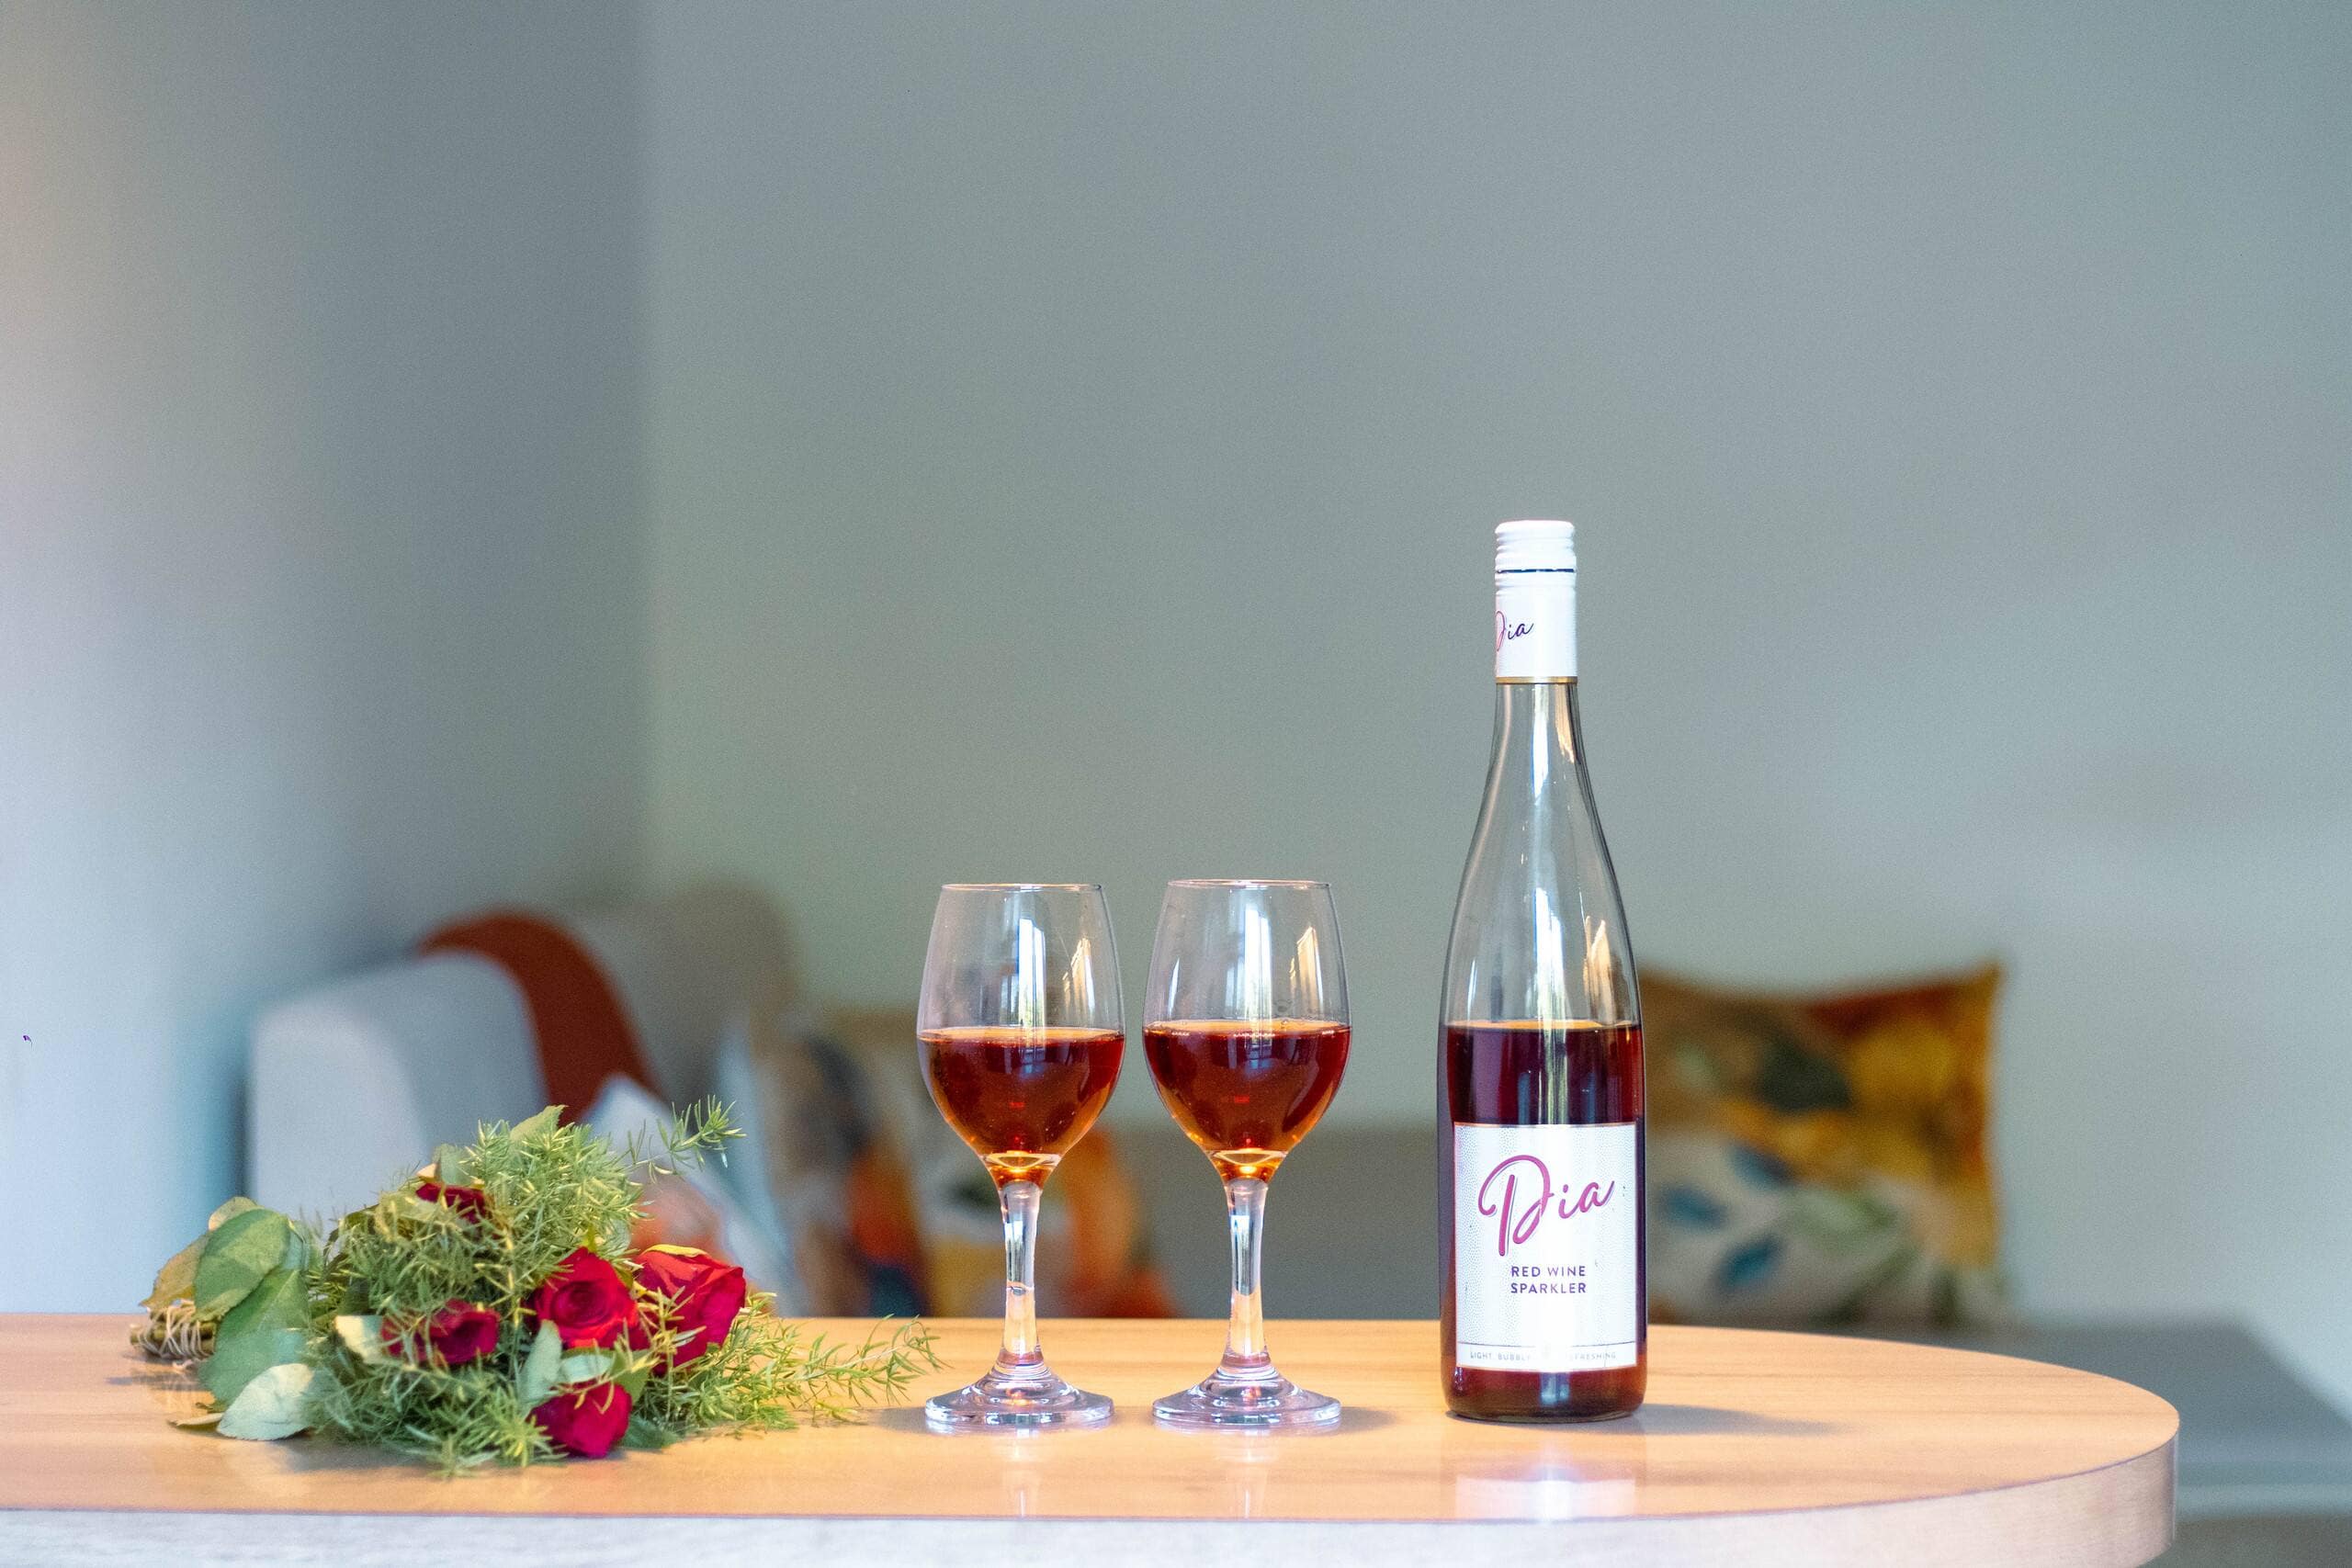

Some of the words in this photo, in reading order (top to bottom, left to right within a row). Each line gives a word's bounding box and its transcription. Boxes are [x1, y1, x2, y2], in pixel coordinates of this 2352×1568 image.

[1477, 1154, 1615, 1257] Dia
[1510, 1265, 1541, 1278] RED
[1547, 1265, 1587, 1278] WINE
[1510, 1282, 1587, 1294] SPARKLER
